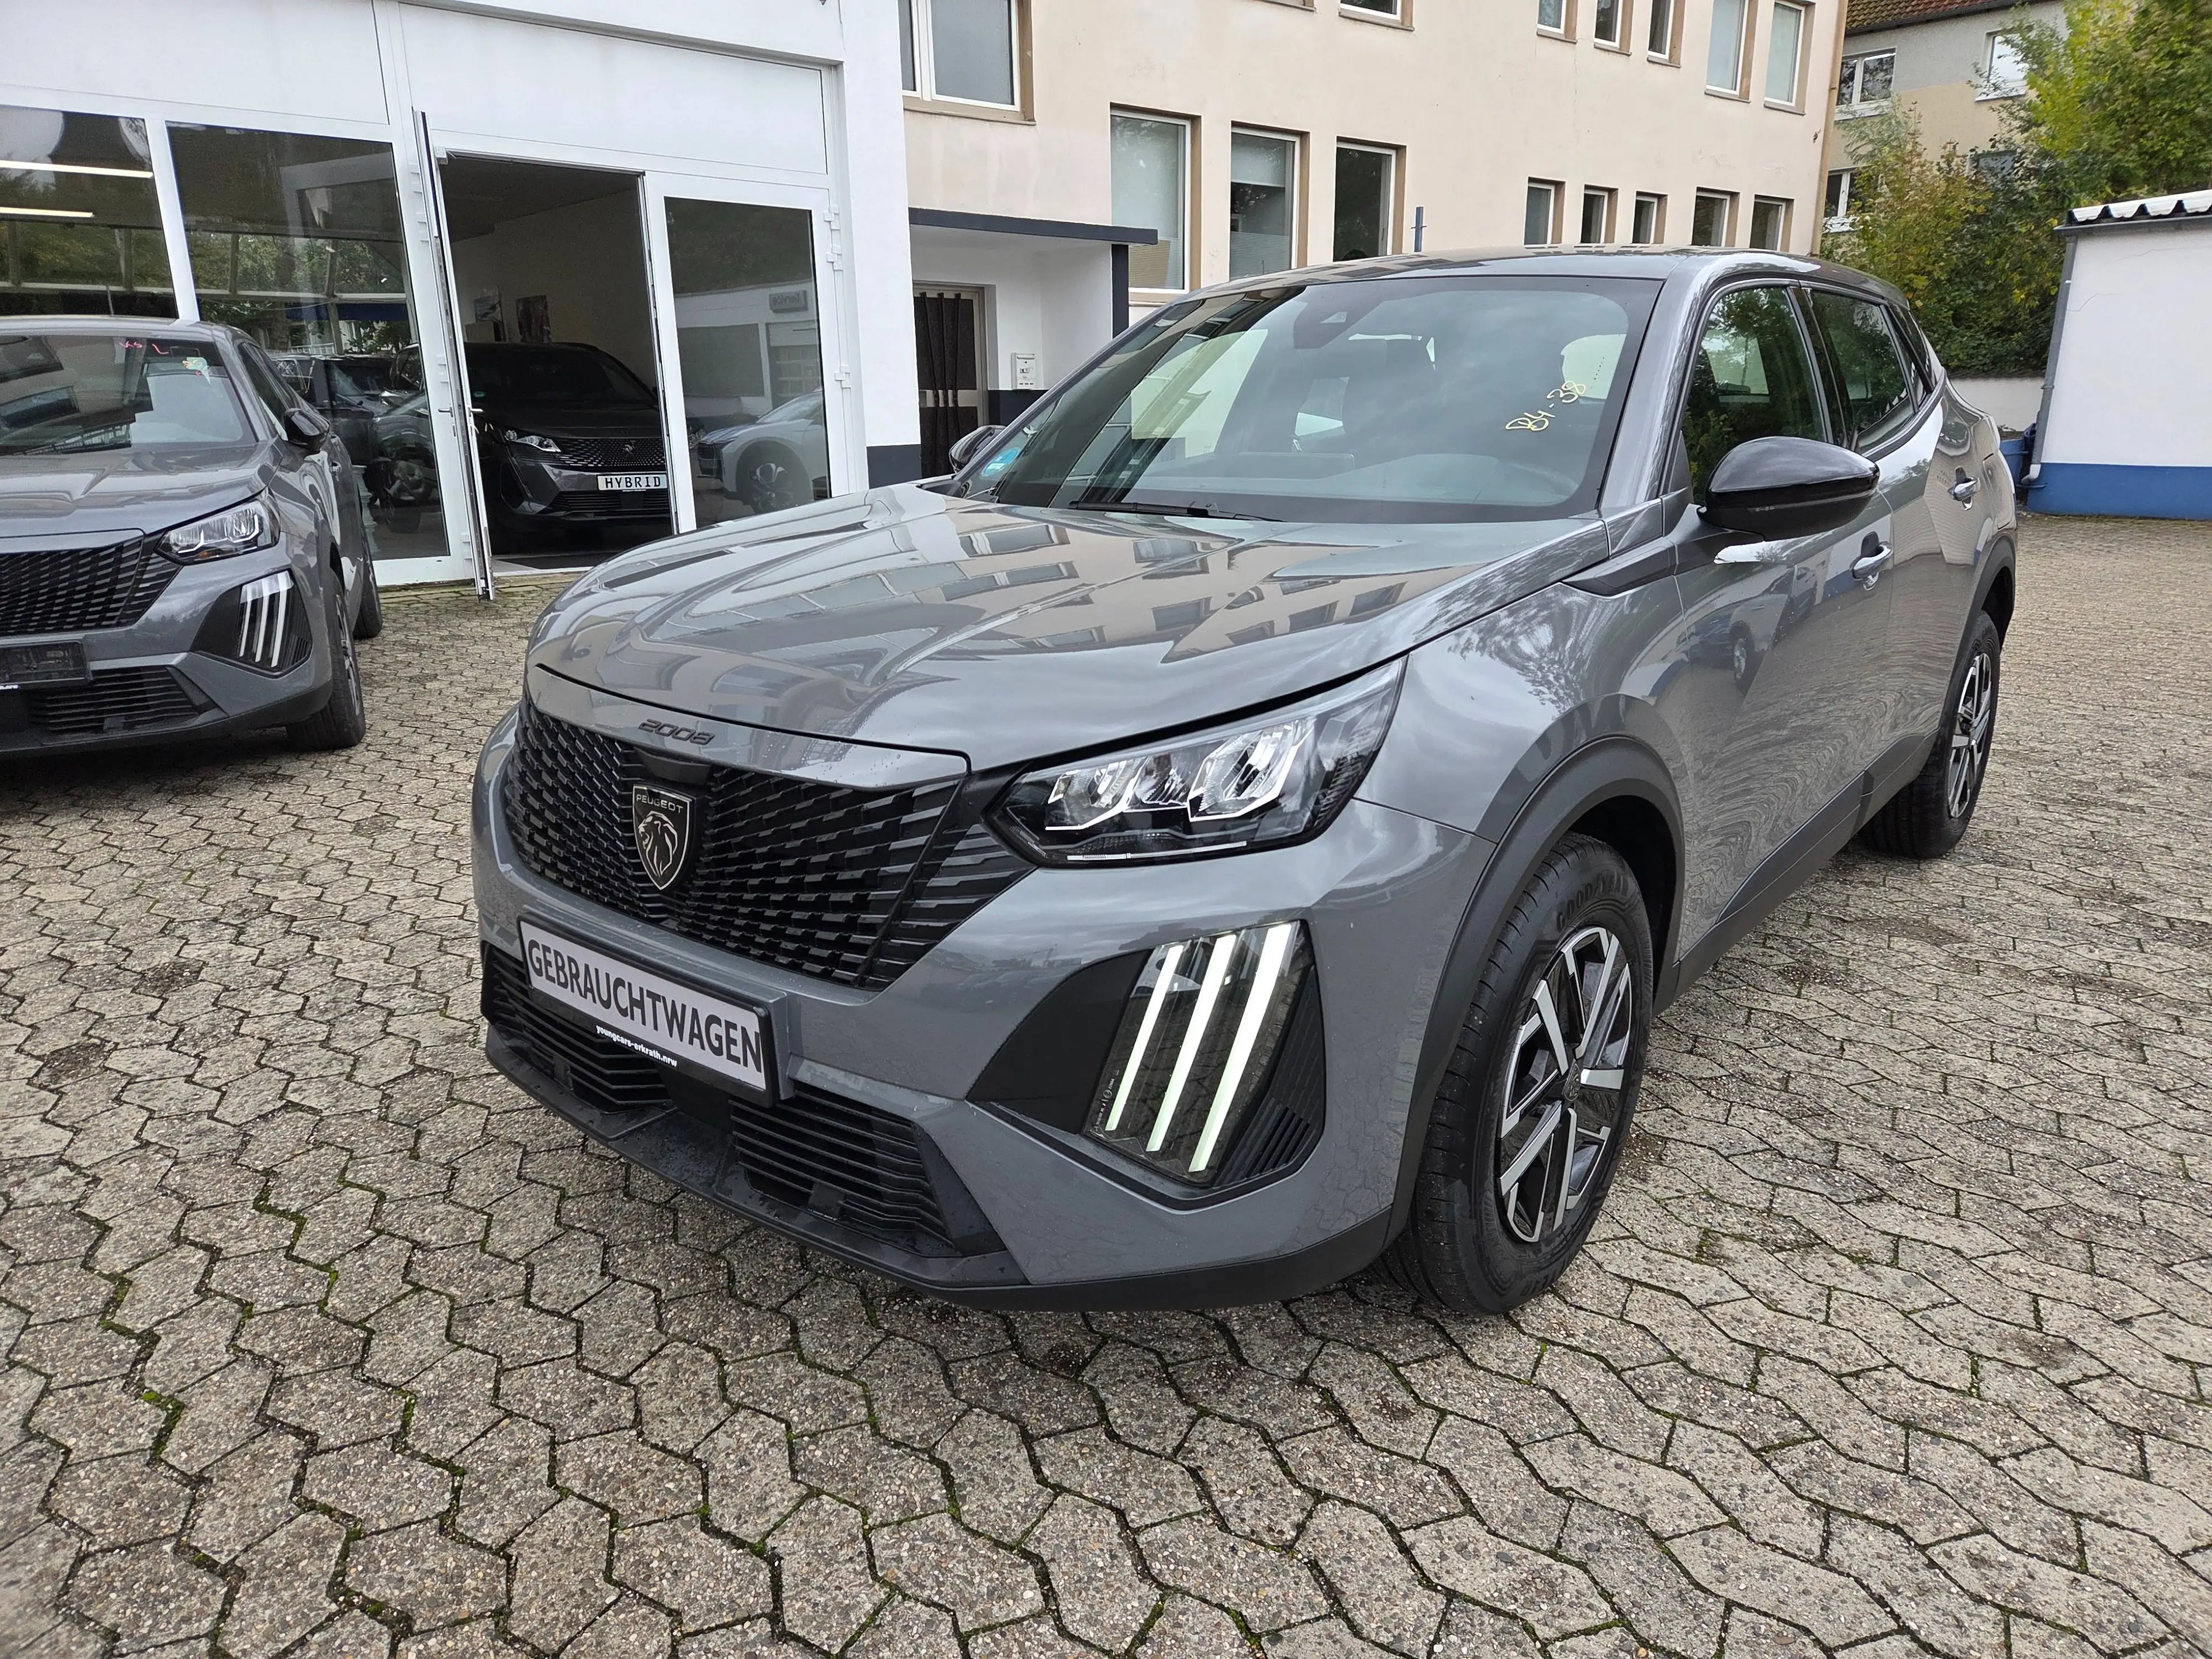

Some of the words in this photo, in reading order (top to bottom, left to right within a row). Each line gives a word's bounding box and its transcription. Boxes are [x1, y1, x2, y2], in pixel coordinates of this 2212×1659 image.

[605, 476, 661, 488] HYBRID
[638, 718, 715, 745] 2008
[636, 794, 683, 813] PEUGEOT
[528, 938, 762, 1073] GEBRAUCHTWAGEN
[596, 1025, 677, 1067] youngcars-erkrath.nrw
